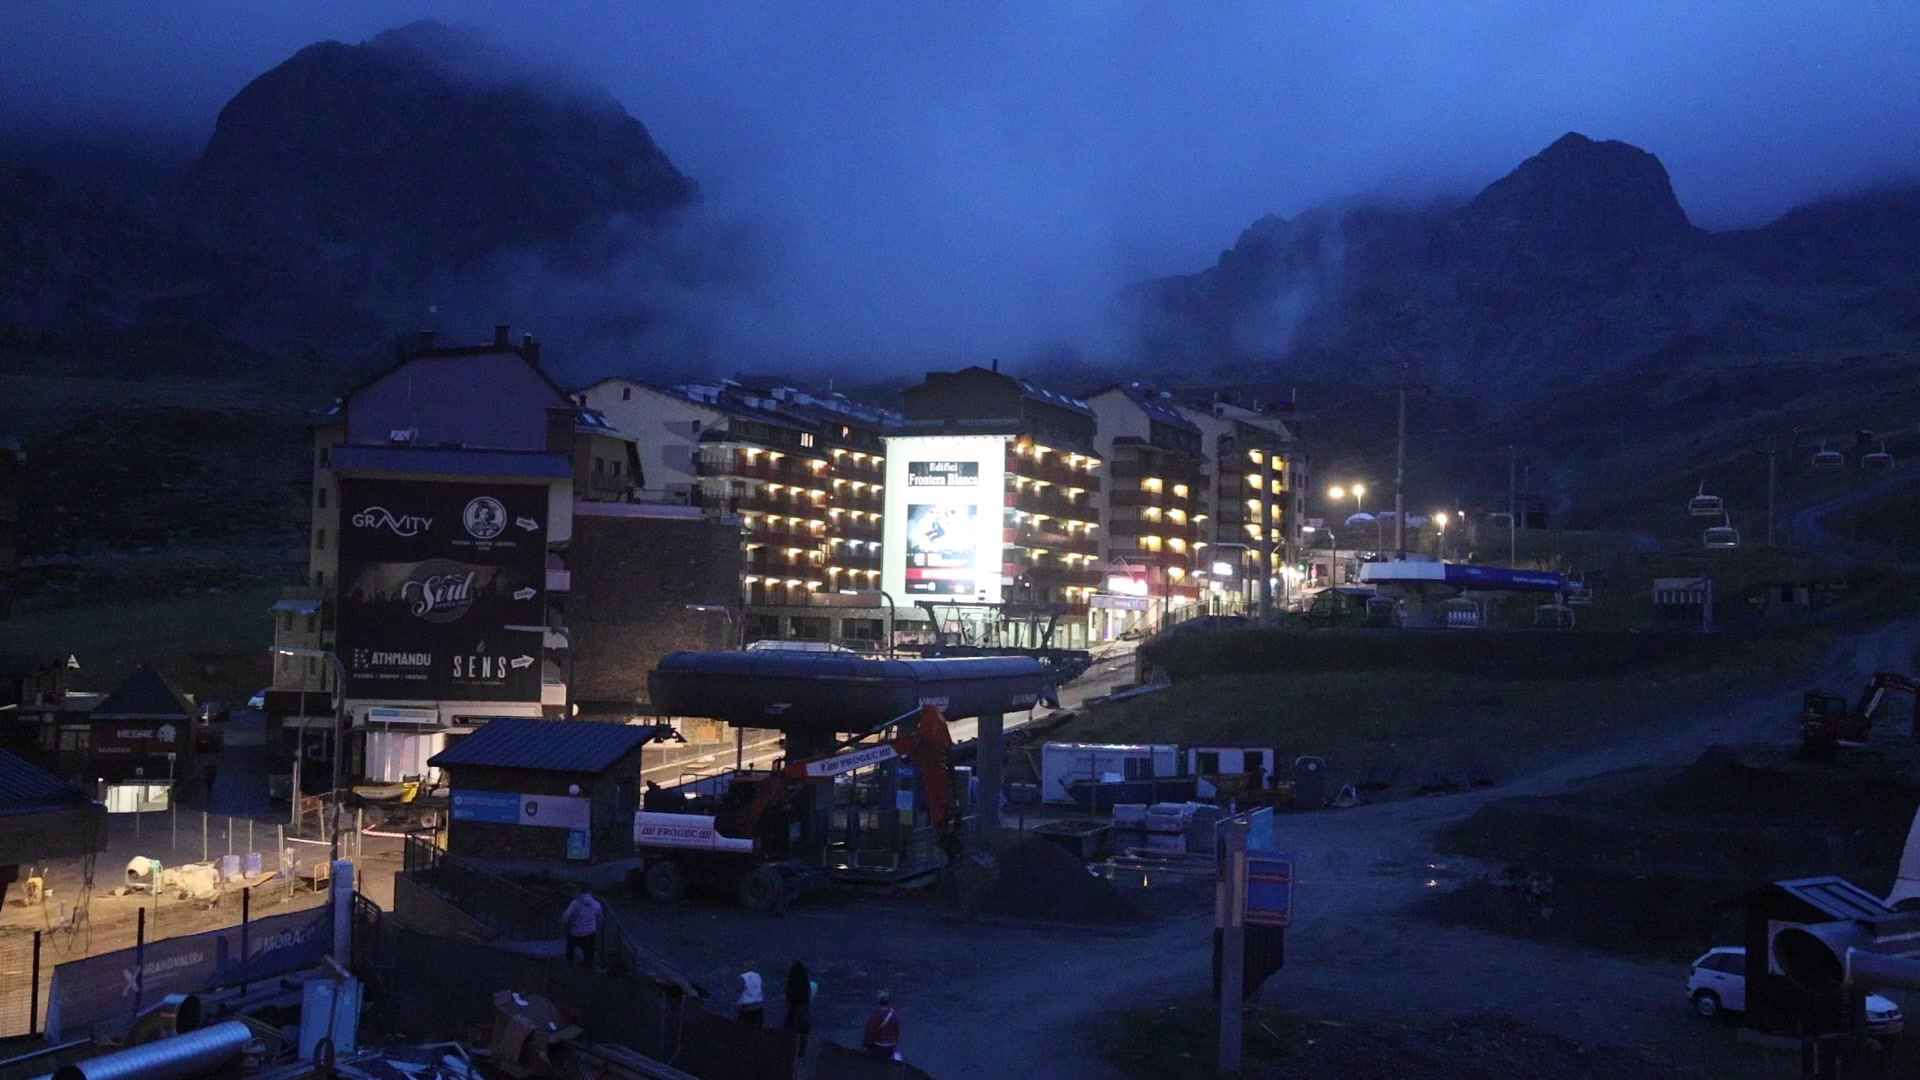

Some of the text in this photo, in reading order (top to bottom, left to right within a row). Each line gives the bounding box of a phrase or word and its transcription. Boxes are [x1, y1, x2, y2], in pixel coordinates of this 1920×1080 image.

[929, 462, 958, 472] Edifici
[909, 473, 946, 486] Frontera
[352, 506, 433, 537] GRAVITY
[401, 571, 475, 617] Soul
[453, 656, 507, 678] SENS
[840, 751, 879, 768] PROGEC
[657, 827, 698, 838] PROGEC
